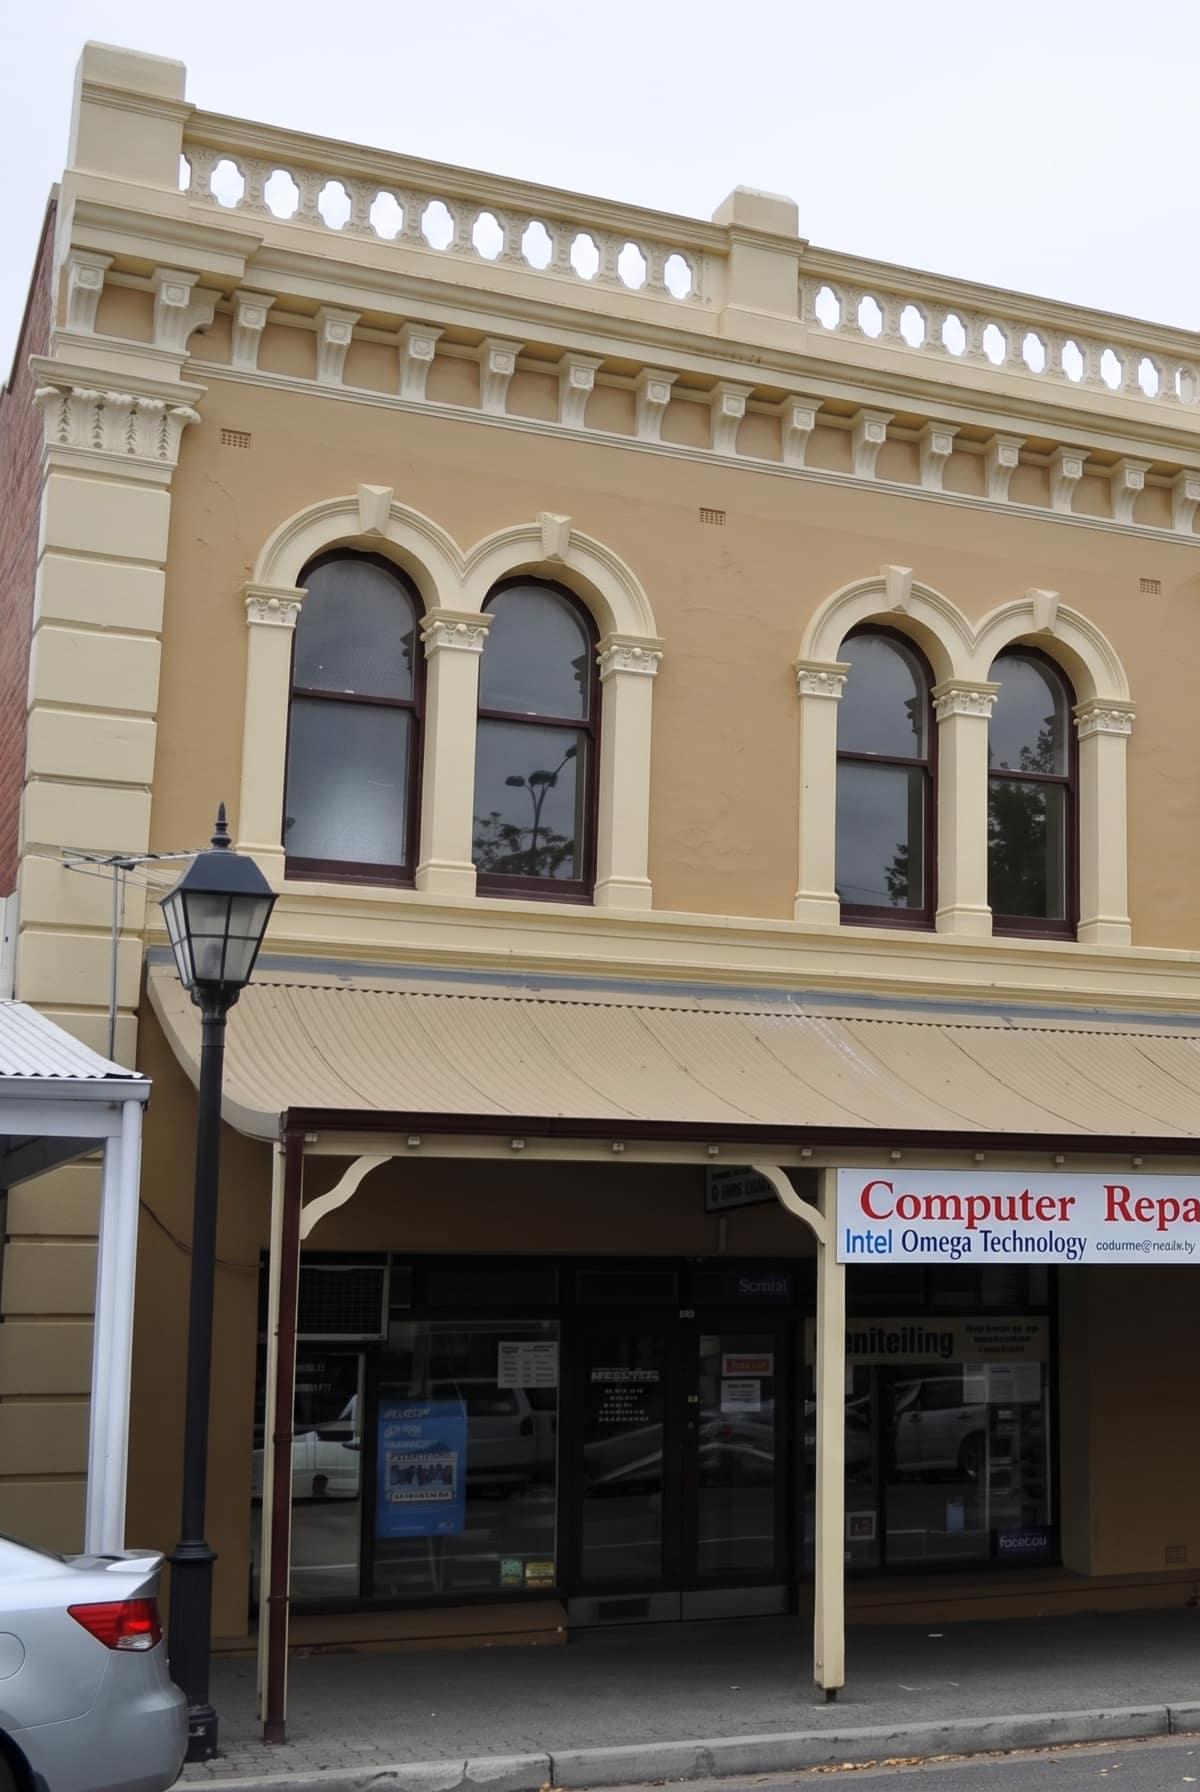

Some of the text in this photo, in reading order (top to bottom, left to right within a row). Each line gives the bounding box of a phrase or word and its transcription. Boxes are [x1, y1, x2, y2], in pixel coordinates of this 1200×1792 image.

[860, 1180, 1077, 1229] Computer
[845, 1228, 893, 1254] Intel
[901, 1229, 972, 1259] Omega
[979, 1229, 1088, 1260] Technology
